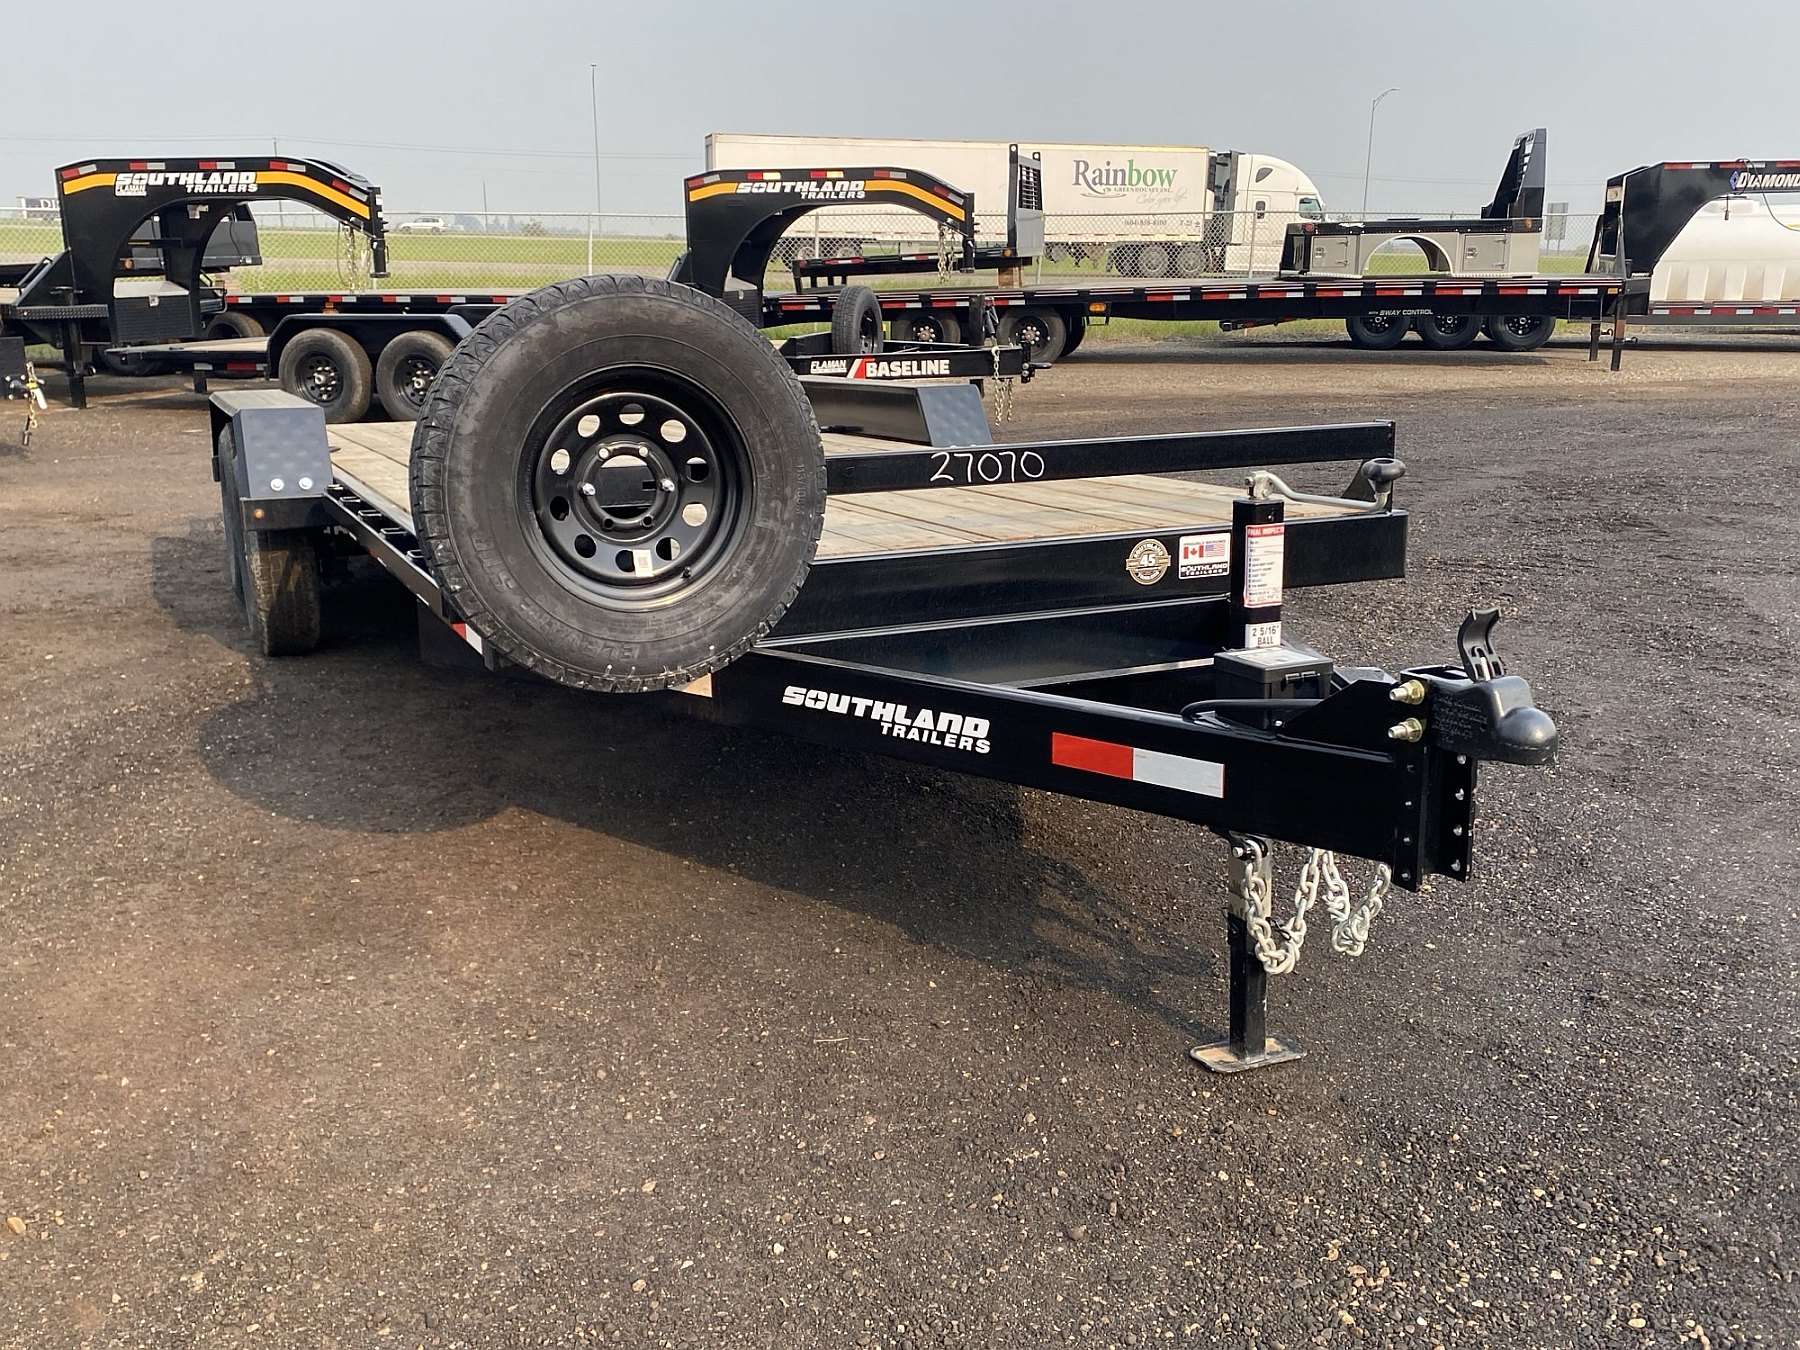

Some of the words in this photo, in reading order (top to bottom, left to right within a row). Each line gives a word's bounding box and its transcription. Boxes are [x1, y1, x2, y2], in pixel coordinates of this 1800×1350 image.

[116, 172, 257, 185] SOUTHLAND
[1072, 159, 1178, 194] Rainbow
[186, 183, 258, 193] TRAILERS
[736, 180, 865, 193] SOUTHLAND
[800, 190, 866, 199] TRAILERS
[1402, 308, 1433, 316] CONTROL
[811, 359, 847, 369] FLAMAN
[865, 359, 950, 377] BASELINE
[930, 451, 1045, 482] 27070
[1180, 562, 1228, 573] SOUTHLAND
[1252, 628, 1257, 637] 2
[1257, 636, 1274, 646] BALL
[782, 685, 990, 739] SOUTHLAND
[880, 722, 991, 754] TRAILERS
